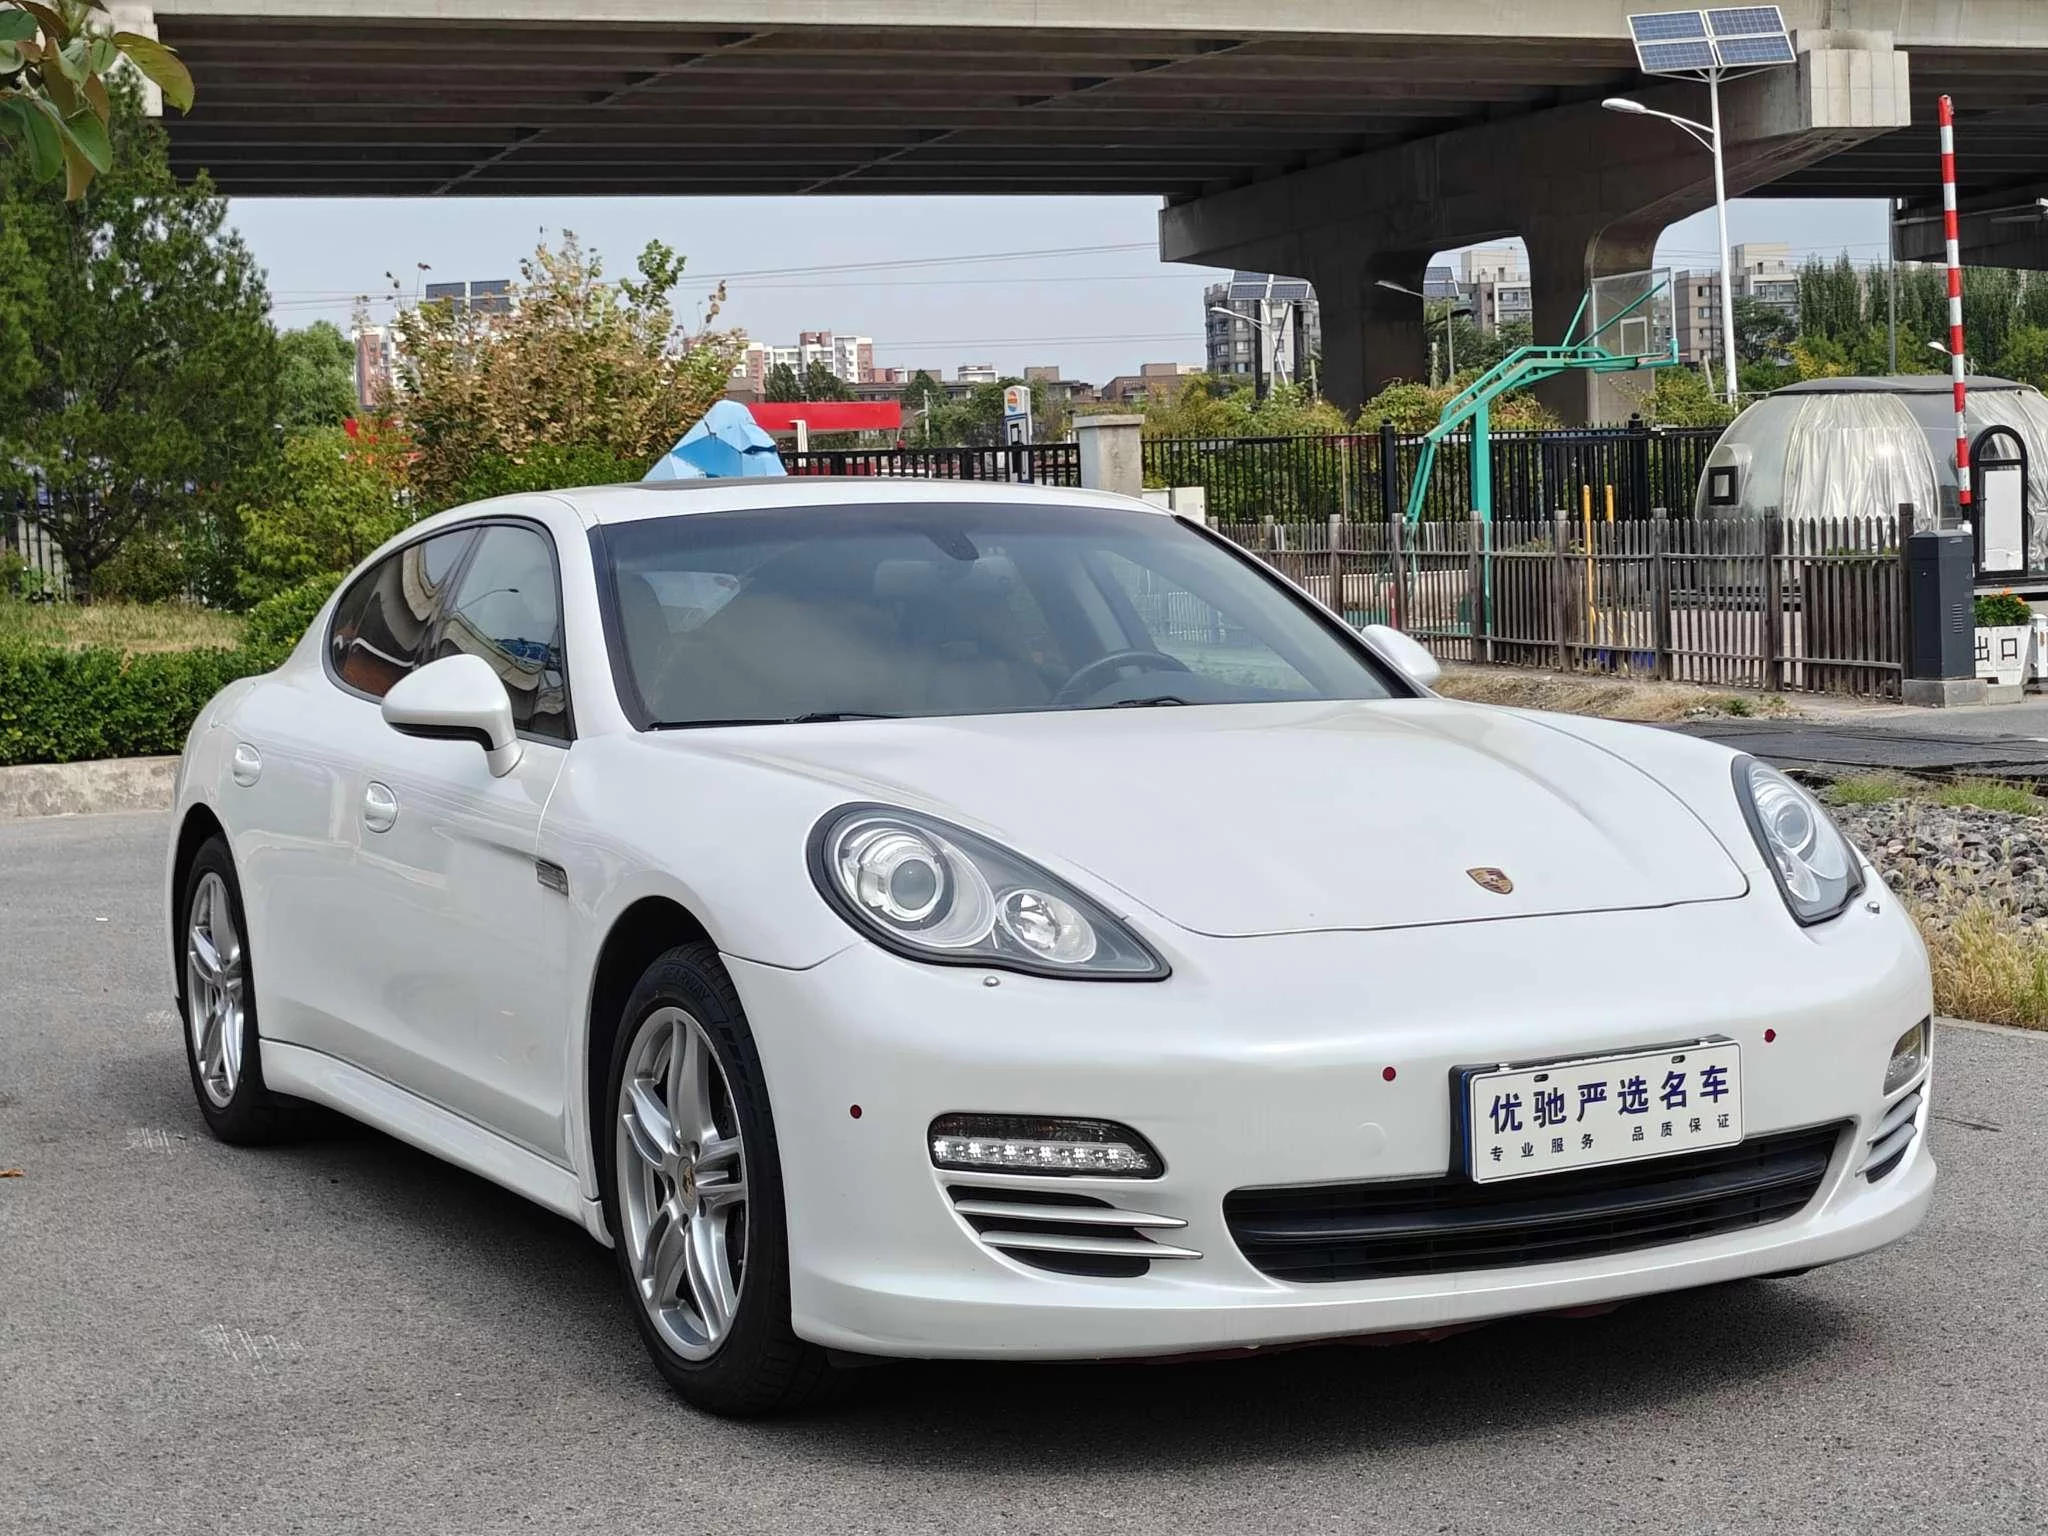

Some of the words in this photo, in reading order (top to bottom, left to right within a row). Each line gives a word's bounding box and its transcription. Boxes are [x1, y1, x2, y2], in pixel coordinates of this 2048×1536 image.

[1974, 636, 2018, 662] 出口
[1489, 1065, 1730, 1135] 优驰严选名车
[1490, 1133, 1595, 1162] 专业服务
[1631, 1113, 1731, 1142] 品质保证
